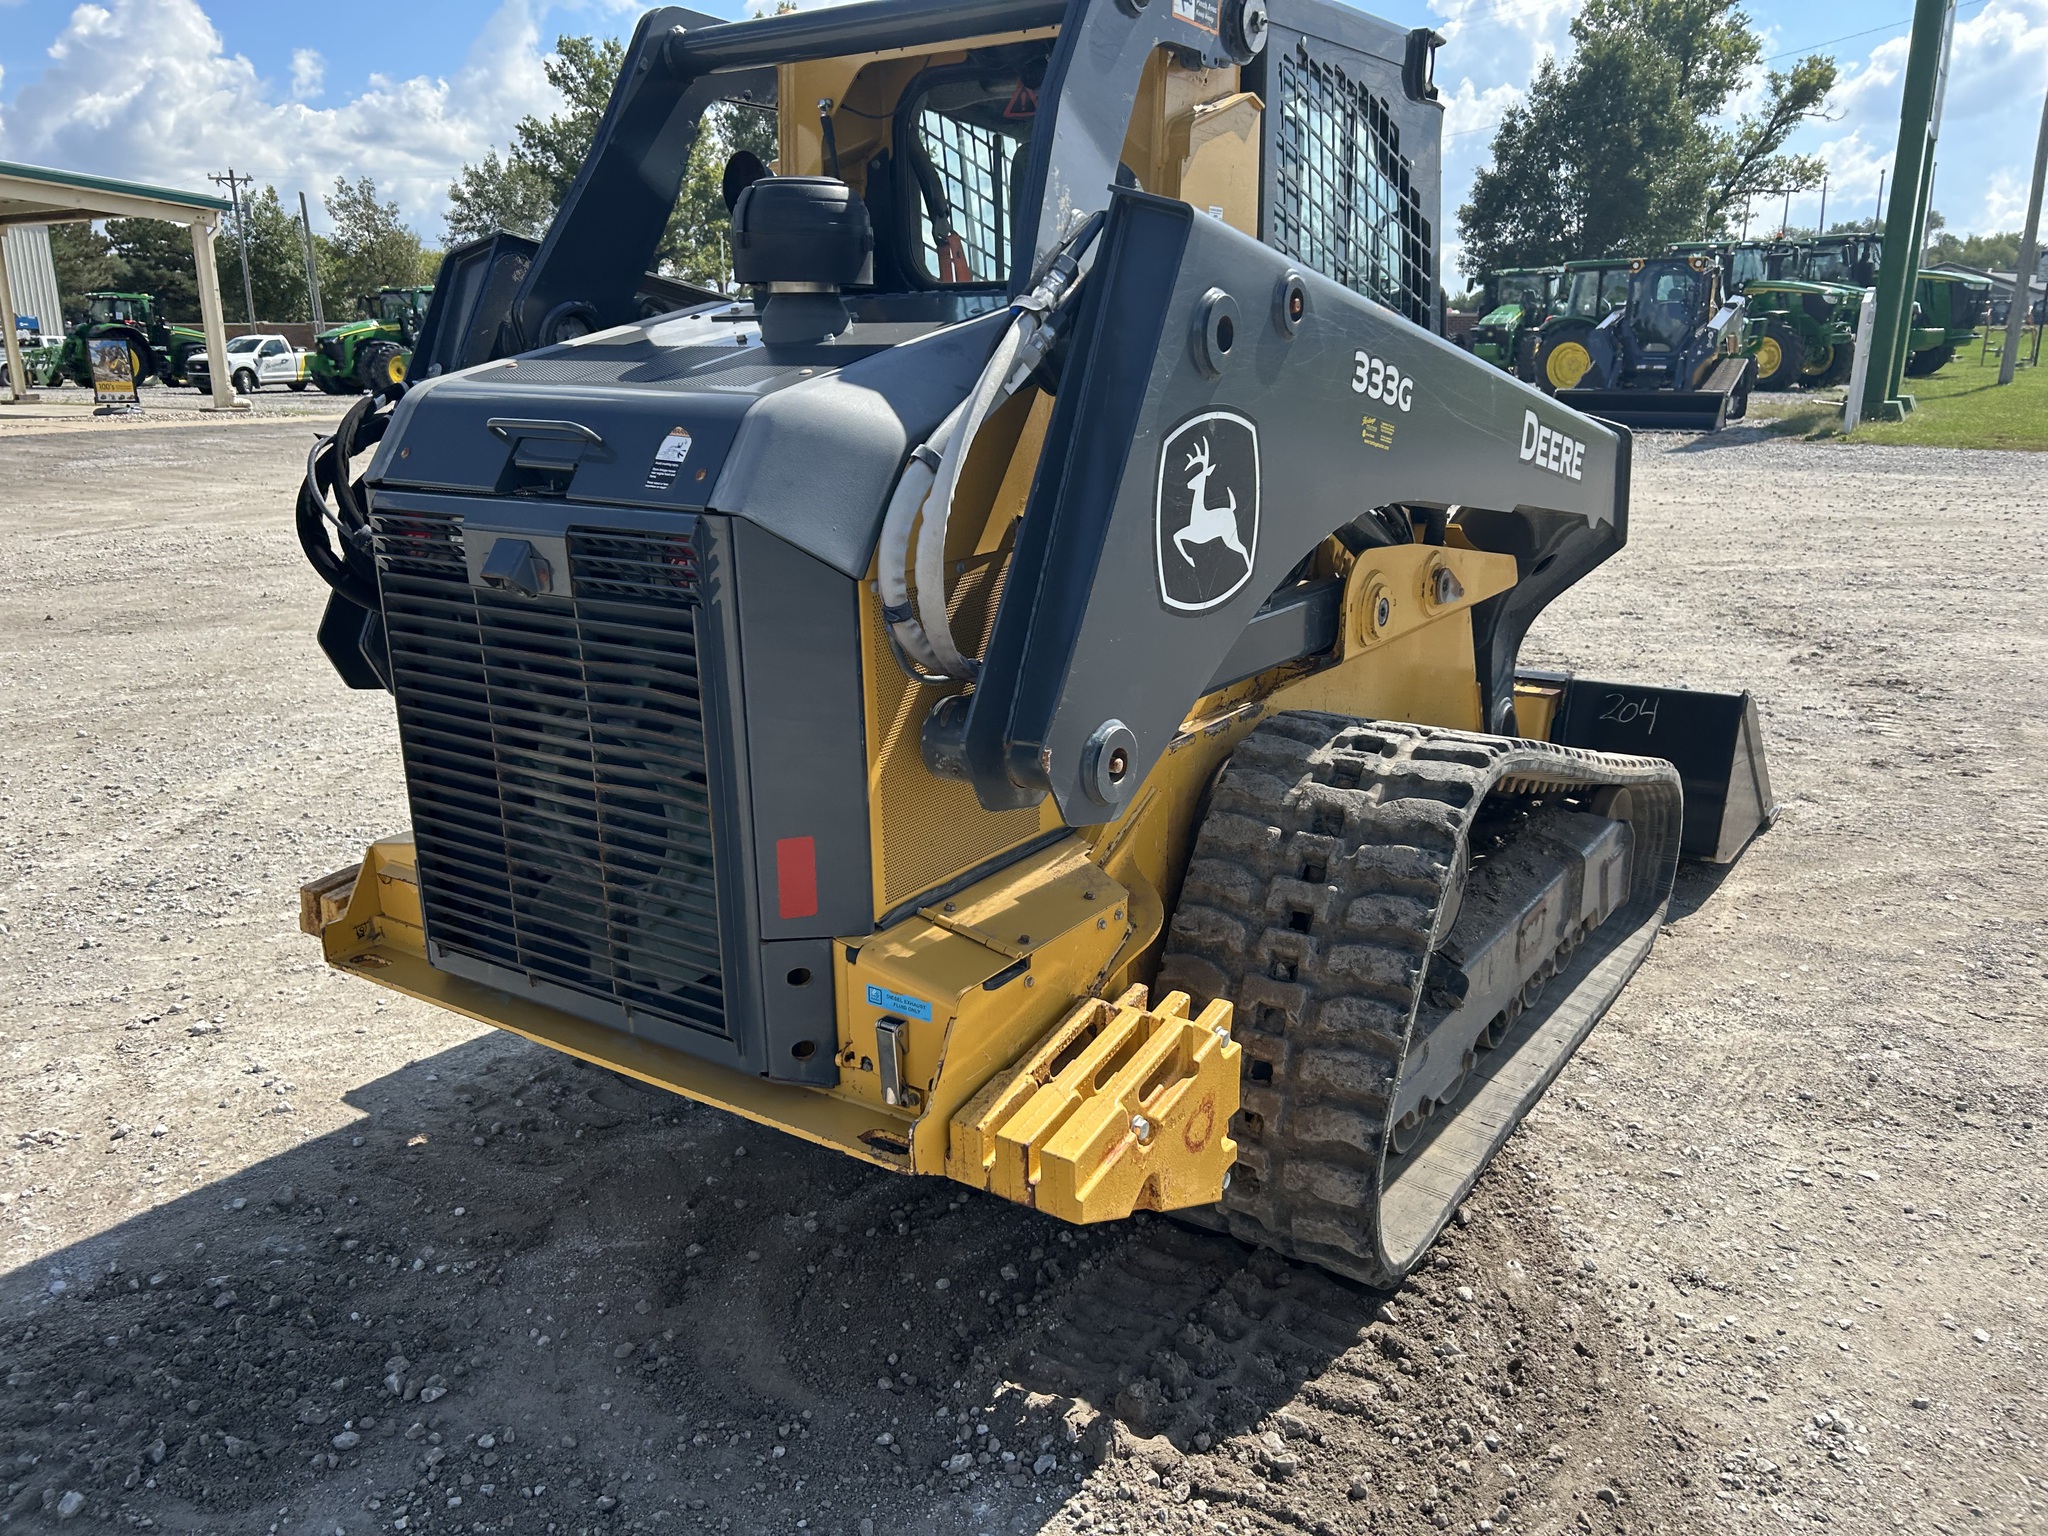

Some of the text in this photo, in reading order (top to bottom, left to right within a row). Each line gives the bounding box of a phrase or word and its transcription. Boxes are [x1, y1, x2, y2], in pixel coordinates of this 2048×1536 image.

[1351, 350, 1414, 412] 333G
[1519, 409, 1586, 481] DEERE
[1599, 693, 1660, 735] 204
[886, 994, 926, 1010] DIESEL EXHAUST
[893, 1002, 921, 1014] FLUID ONLY
